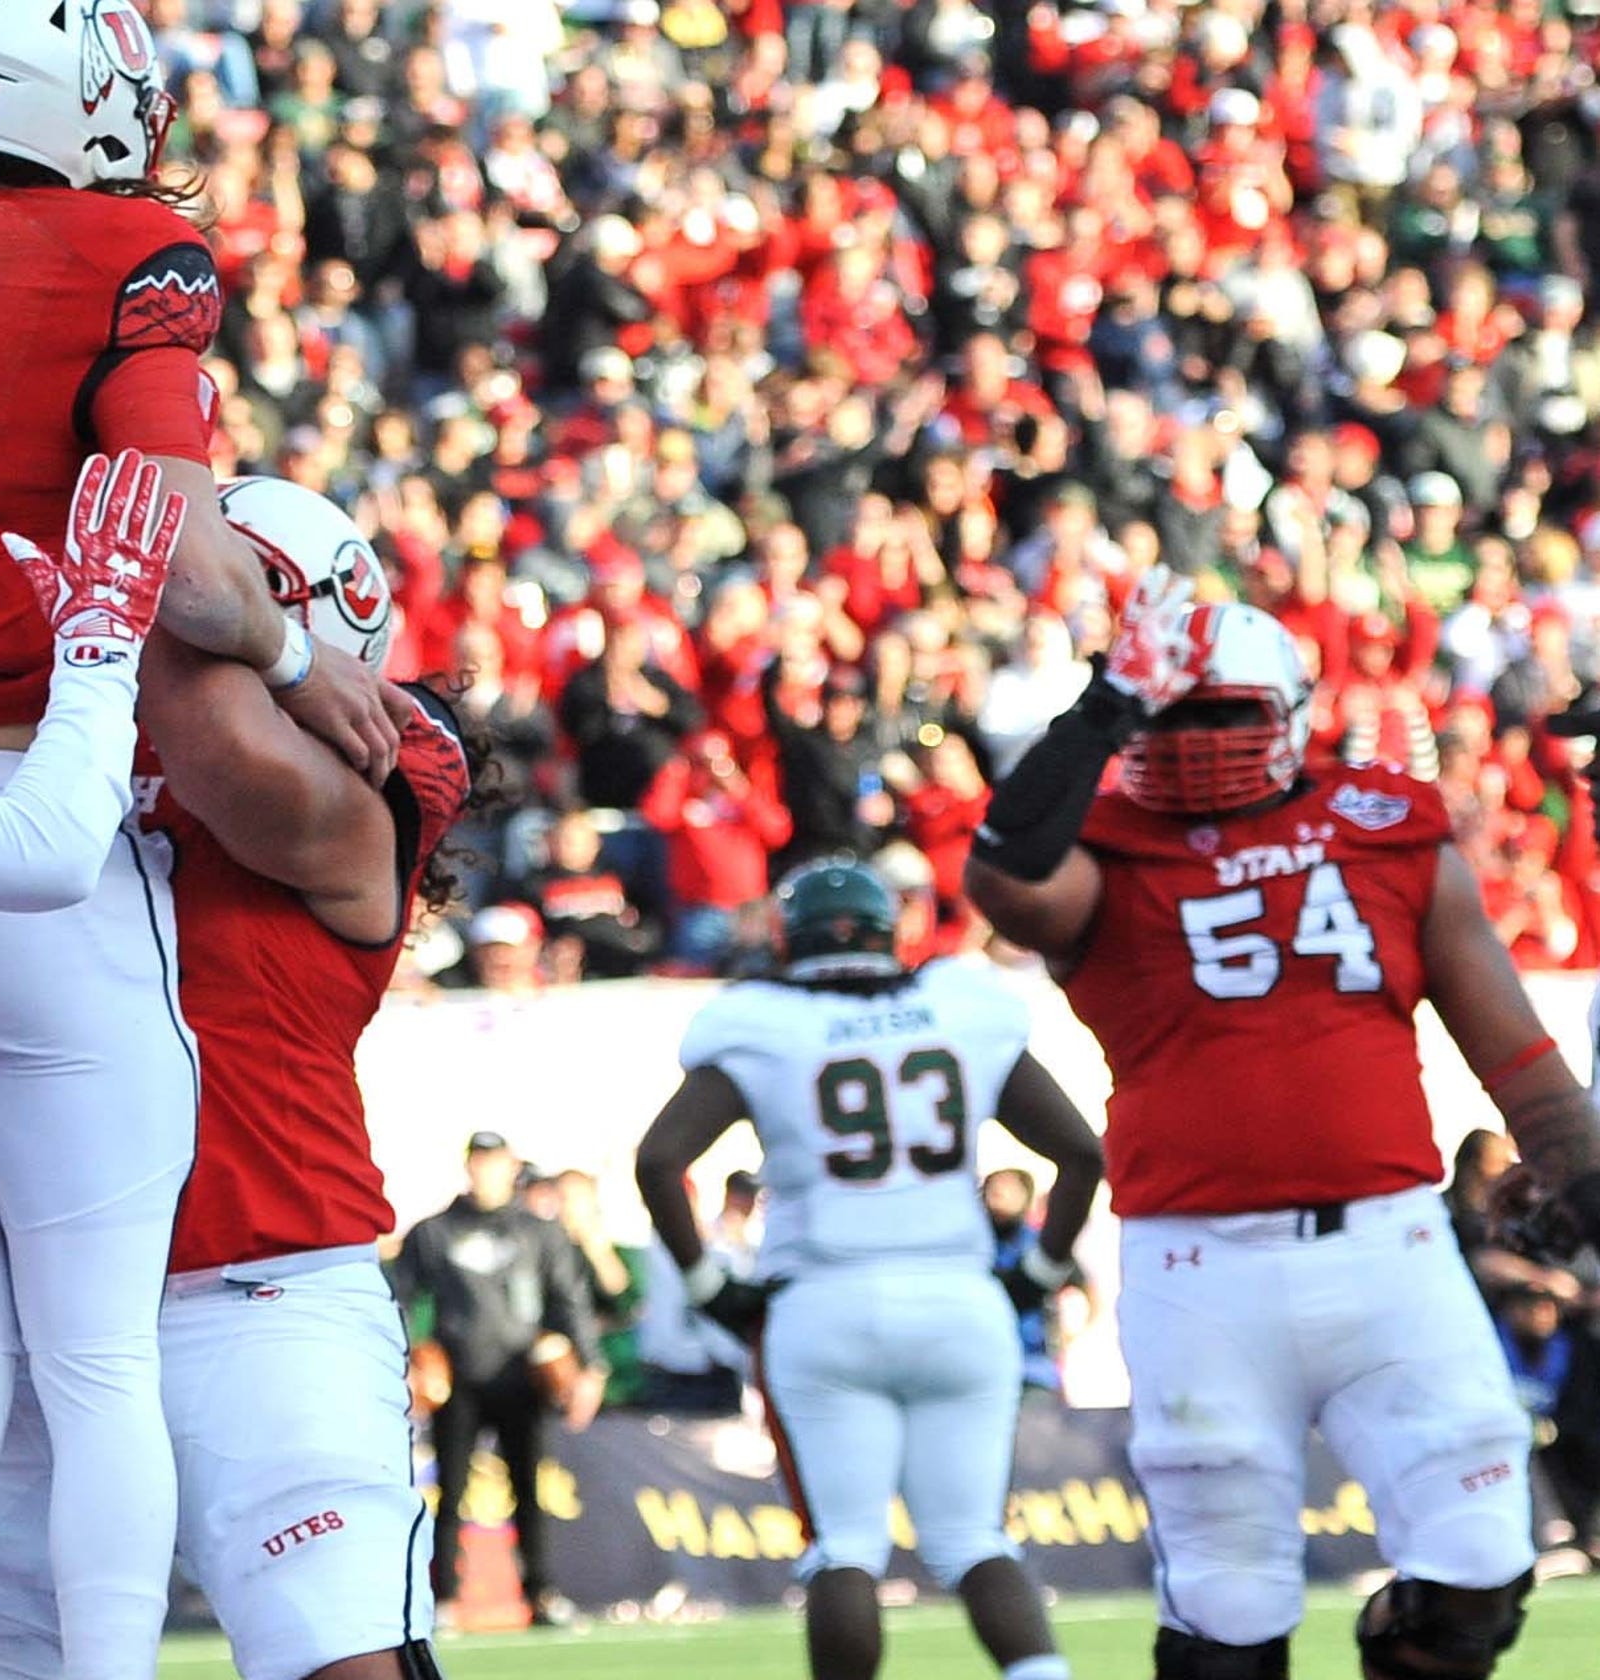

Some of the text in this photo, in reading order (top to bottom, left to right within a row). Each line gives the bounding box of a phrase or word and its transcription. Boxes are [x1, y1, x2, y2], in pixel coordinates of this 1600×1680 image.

[101, 10, 148, 71] U
[1214, 842, 1325, 886] UTAH
[1179, 862, 1384, 1000] 54
[818, 1048, 967, 1182] 93
[262, 1510, 344, 1557] UTES
